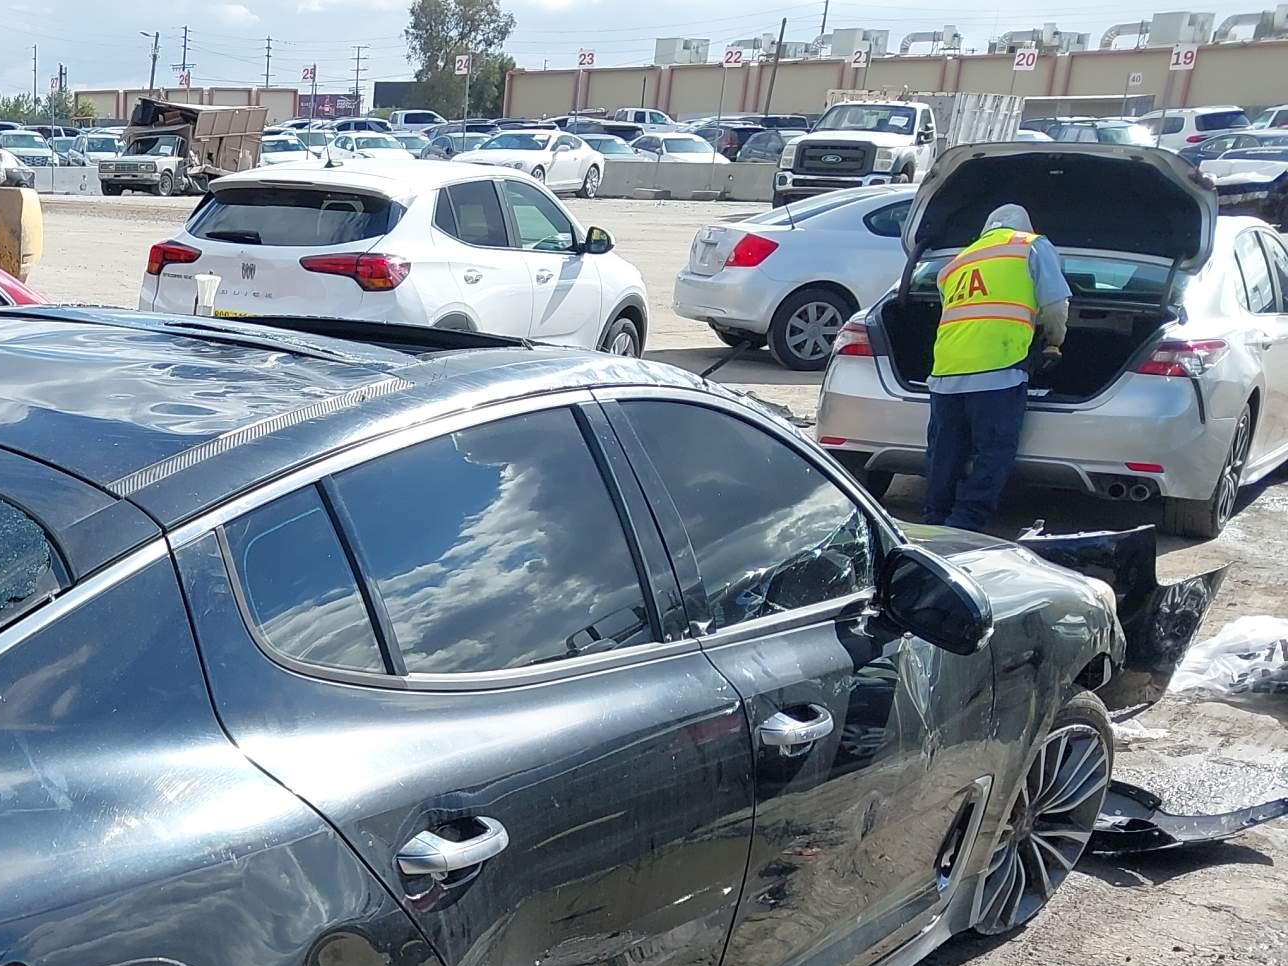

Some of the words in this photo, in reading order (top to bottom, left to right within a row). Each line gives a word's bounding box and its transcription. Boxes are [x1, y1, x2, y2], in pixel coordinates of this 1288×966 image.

[579, 52, 595, 66] 23
[725, 50, 742, 64] 22
[1015, 52, 1035, 67] 20
[1171, 50, 1194, 66] 19
[50, 77, 59, 89] 27
[1130, 74, 1141, 83] 40
